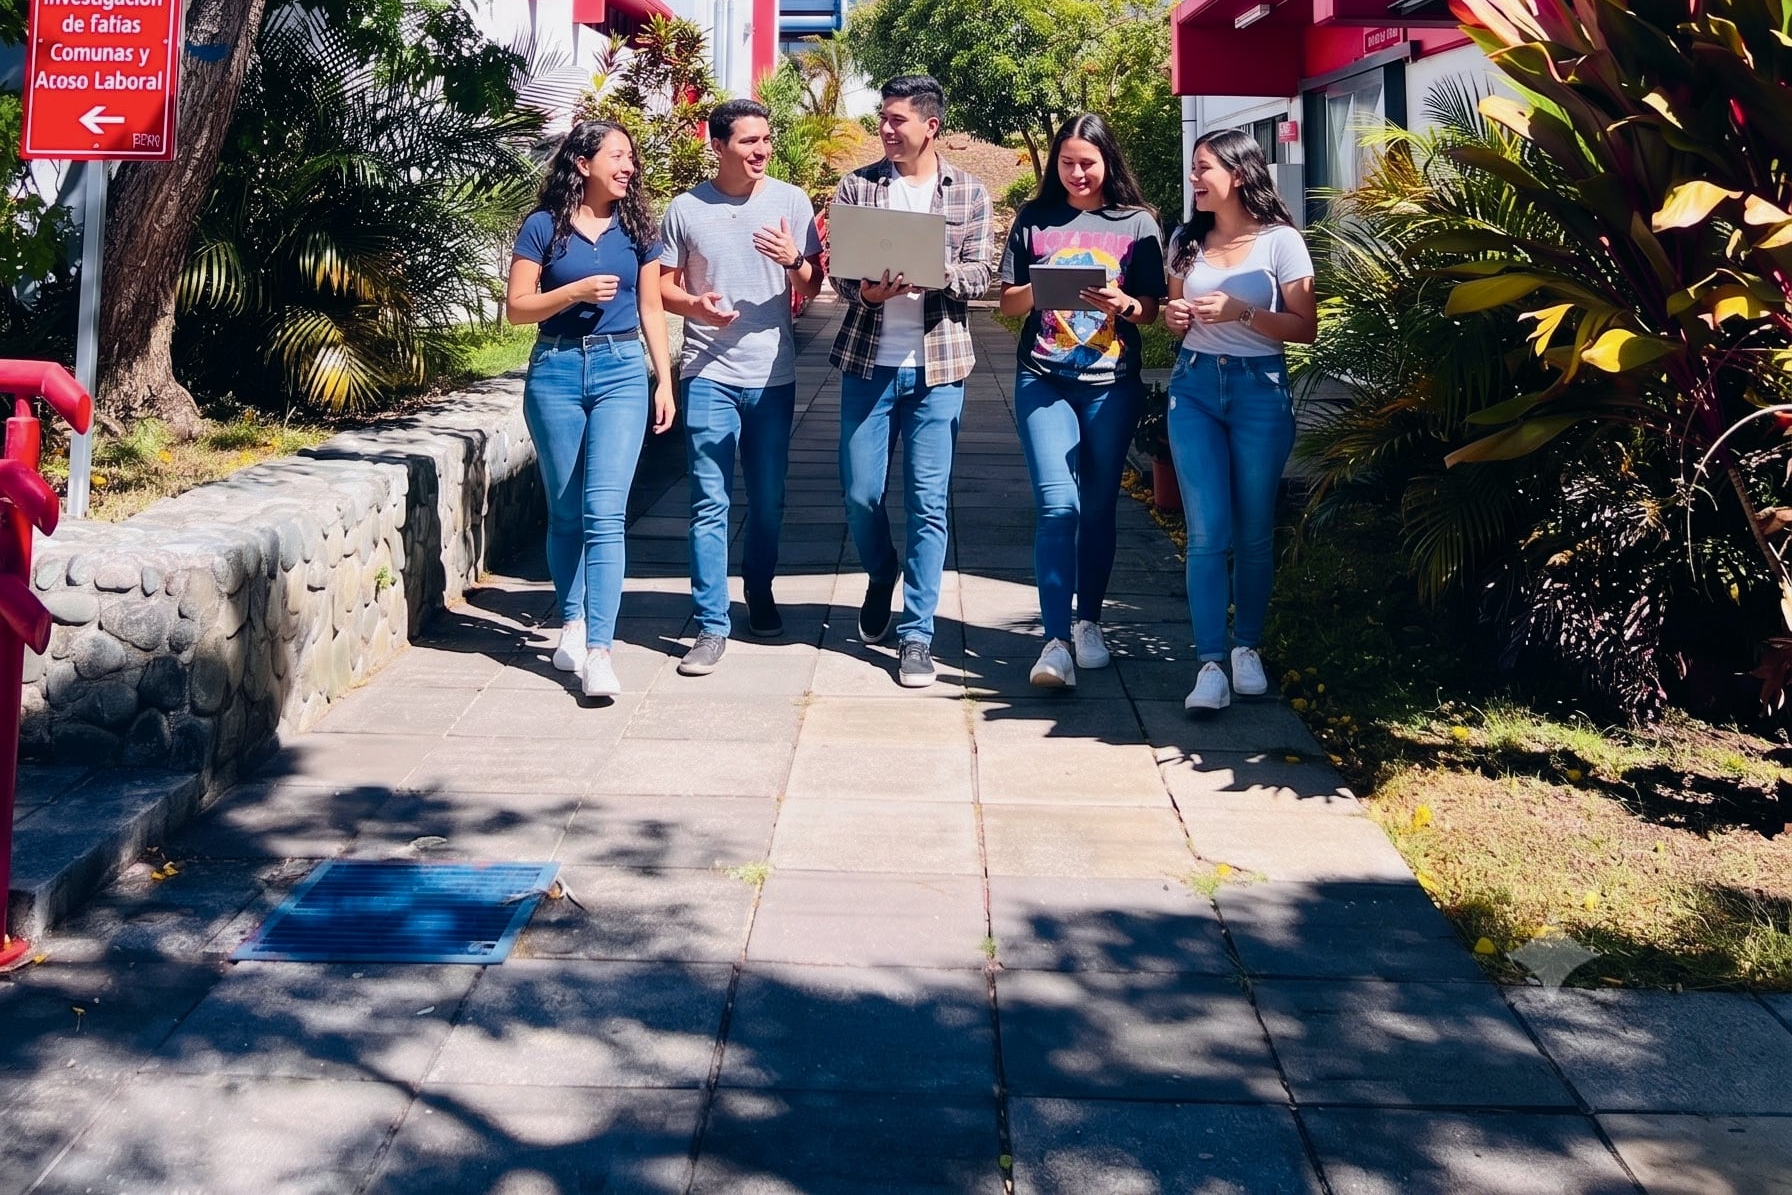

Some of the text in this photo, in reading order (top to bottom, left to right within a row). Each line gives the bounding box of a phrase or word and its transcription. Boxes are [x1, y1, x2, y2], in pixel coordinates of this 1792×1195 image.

[62, 14, 85, 33] de
[50, 43, 150, 67] Comunas y
[35, 71, 162, 90] Acoso Laboral
